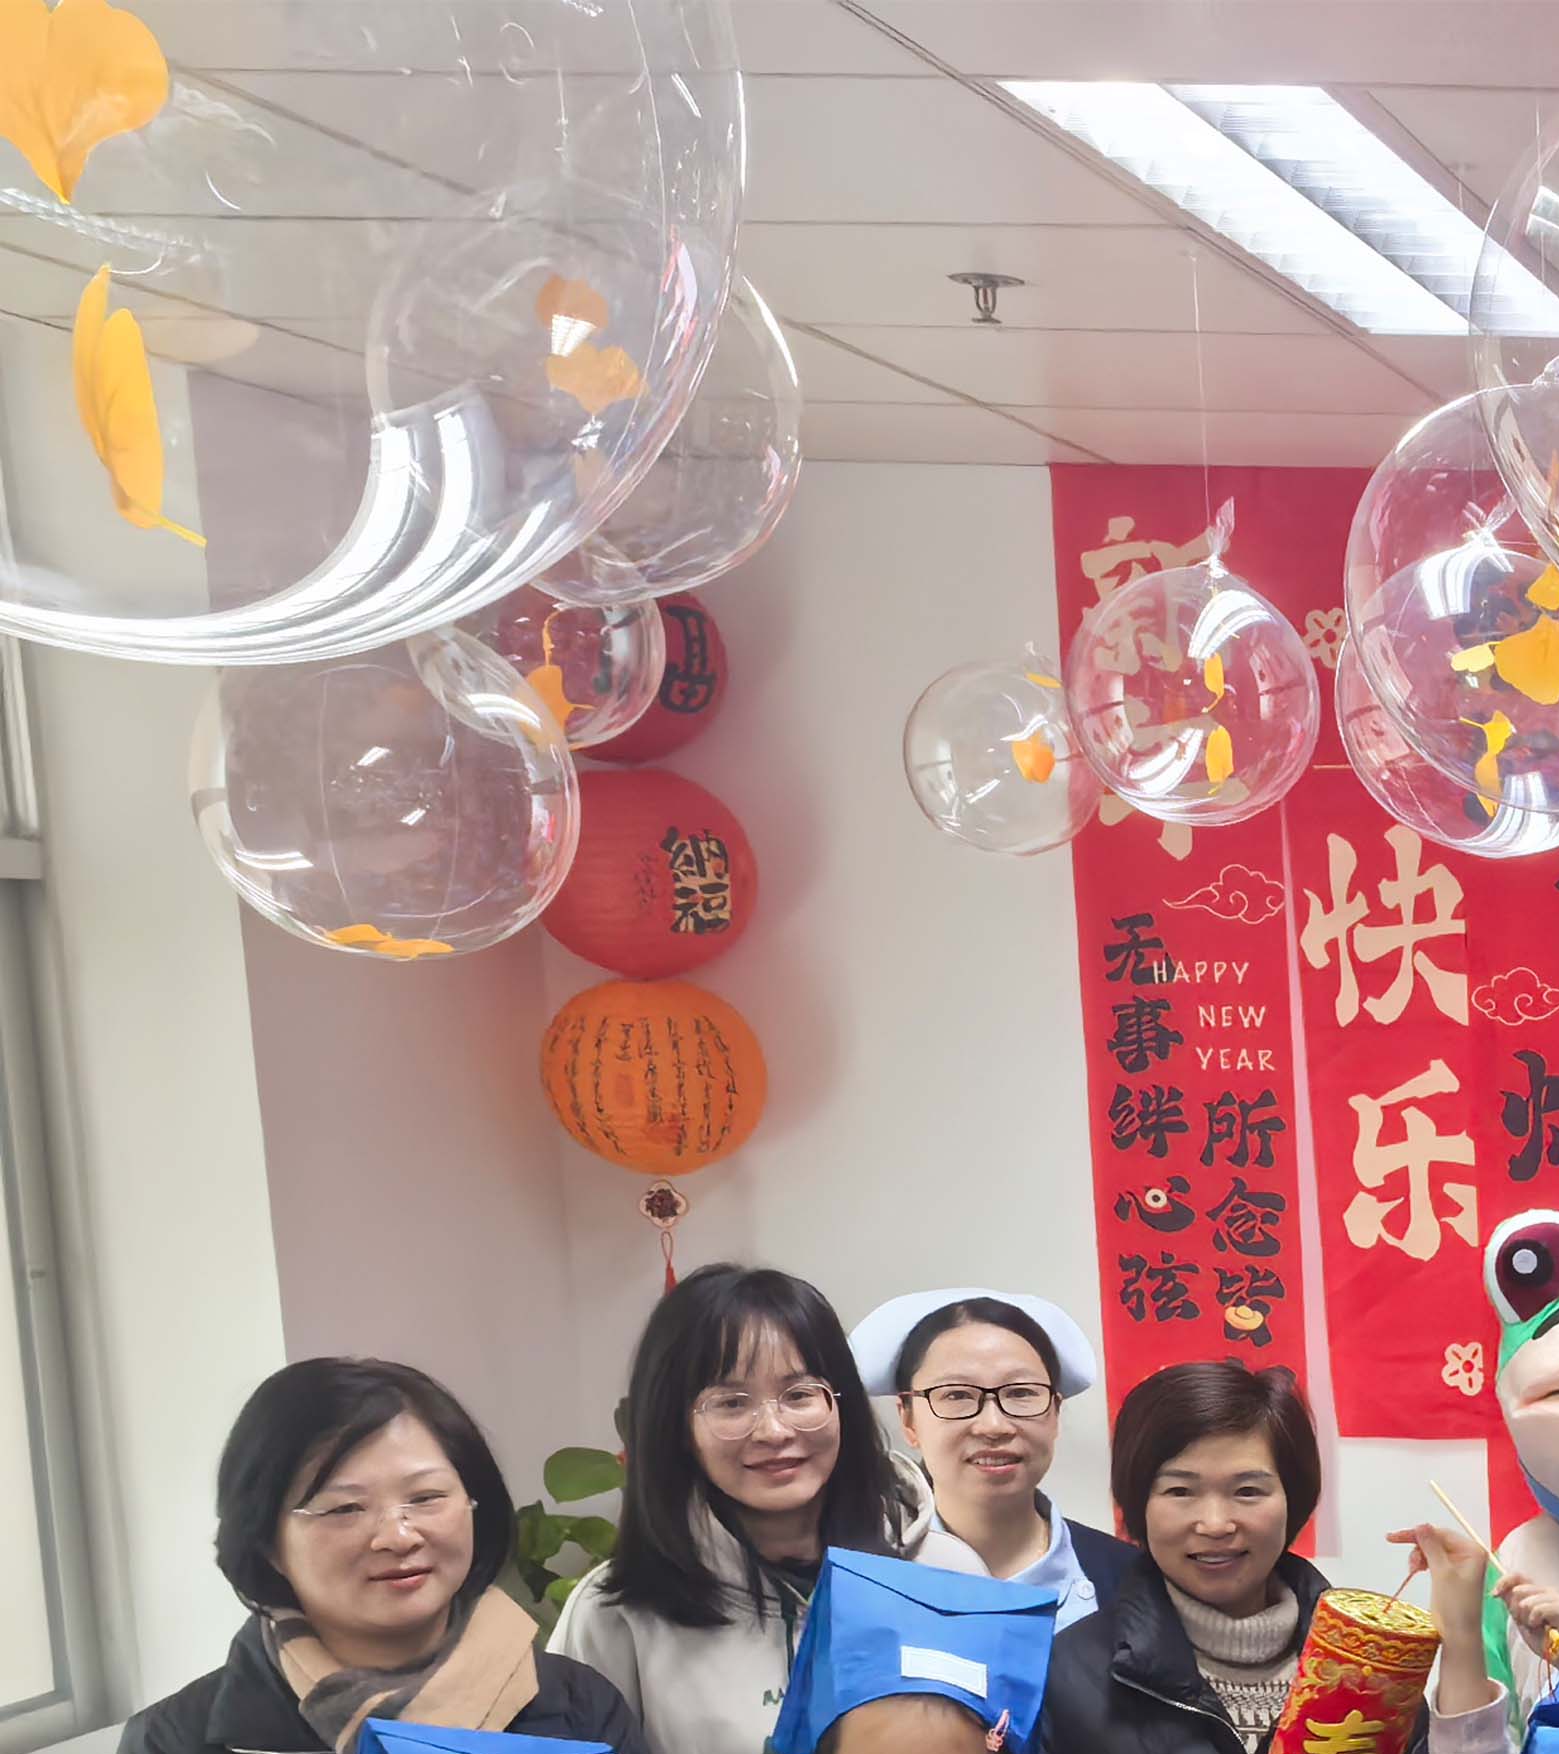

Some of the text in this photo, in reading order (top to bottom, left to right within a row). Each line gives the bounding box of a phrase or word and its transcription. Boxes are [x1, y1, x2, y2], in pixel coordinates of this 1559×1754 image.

[1153, 961, 1249, 984] HAPPY
[1199, 1005, 1266, 1028] NEW
[1300, 823, 1480, 1262] 快乐
[1195, 1047, 1275, 1071] YEAR
